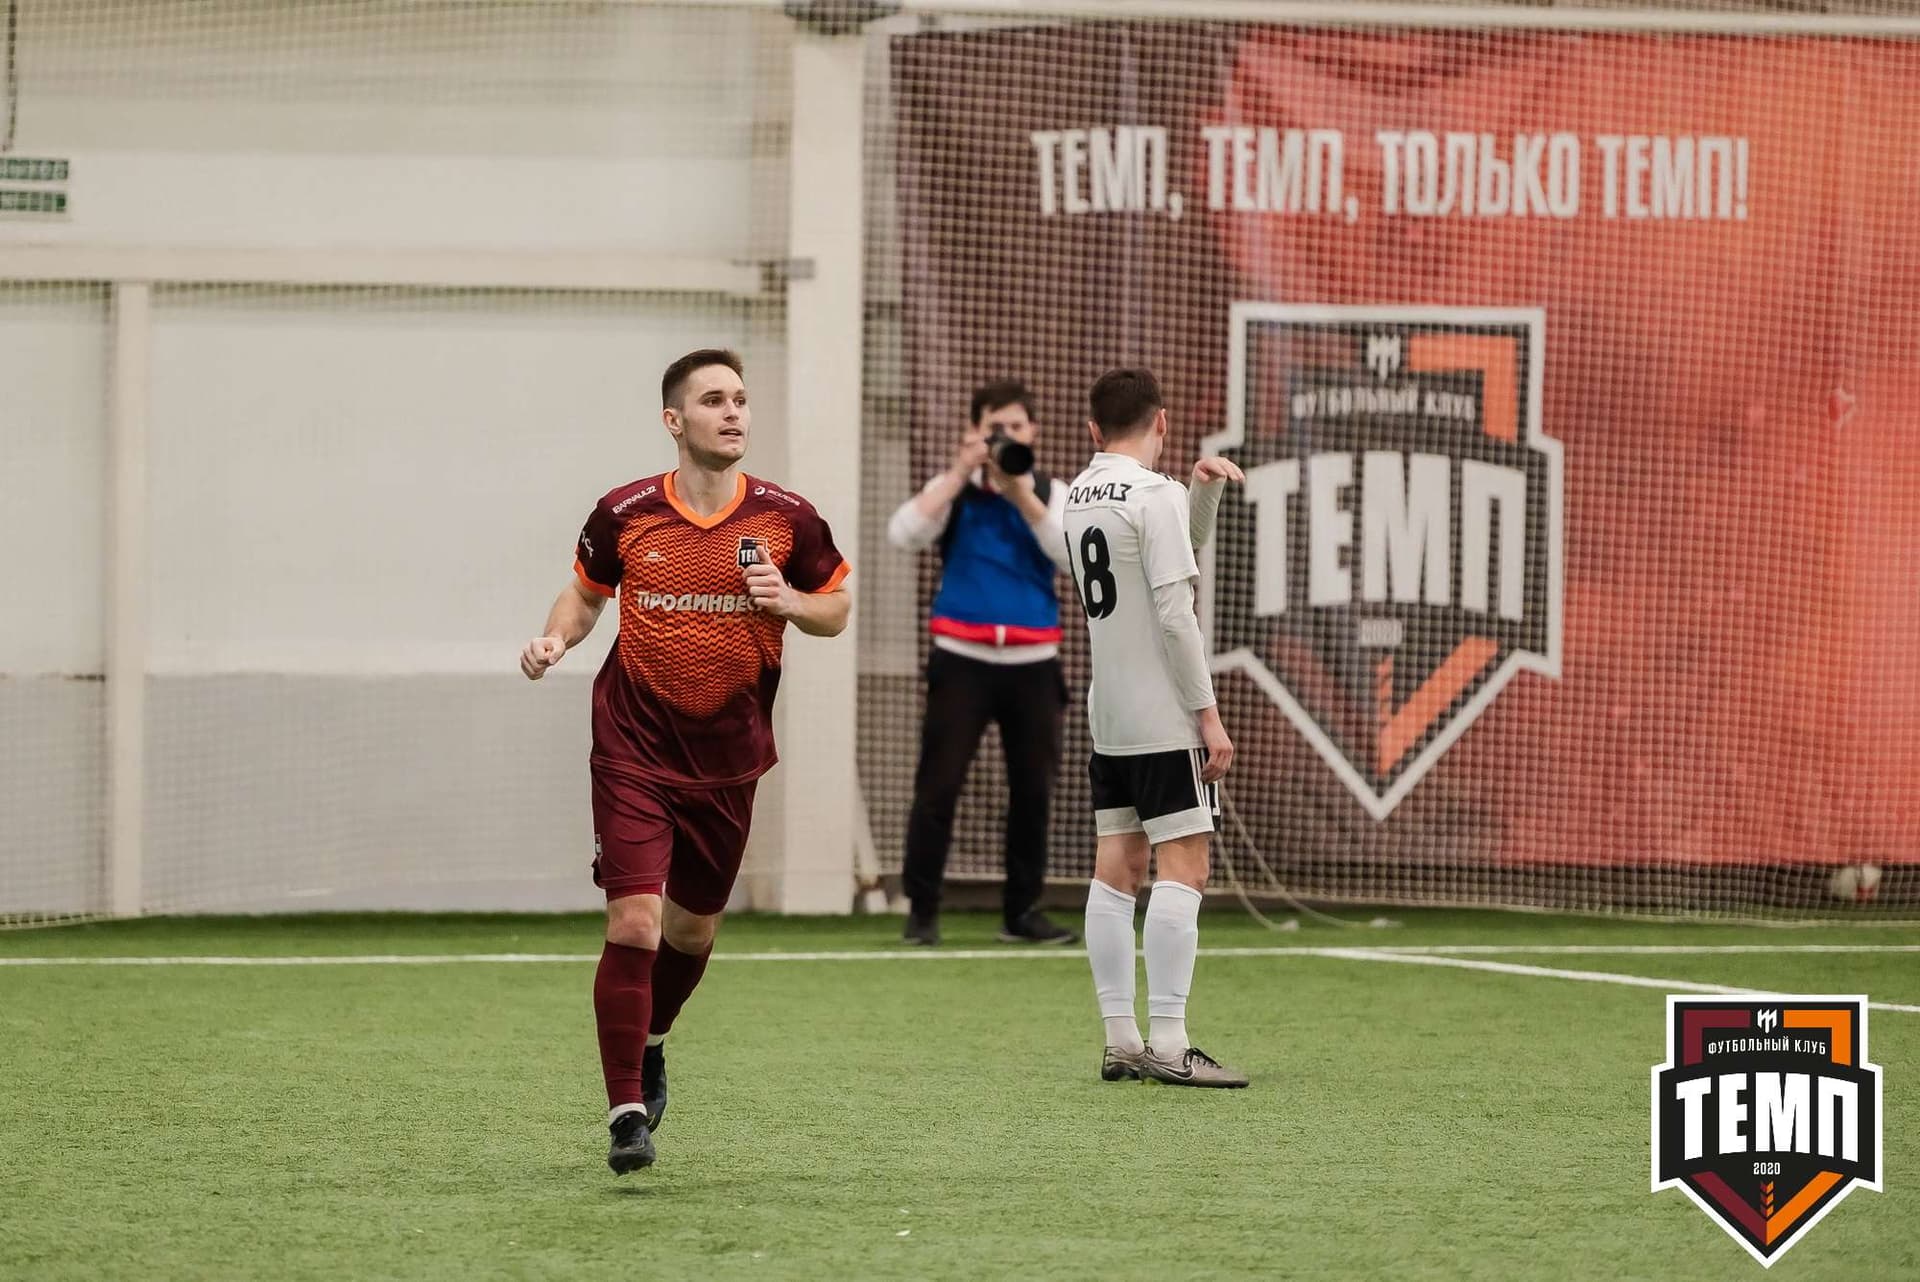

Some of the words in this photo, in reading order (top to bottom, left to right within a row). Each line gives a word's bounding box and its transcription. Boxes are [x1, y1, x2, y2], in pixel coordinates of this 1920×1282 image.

[1031, 126, 1184, 220] ТЕМП,
[1200, 127, 1359, 223] ТЕМП,
[1377, 130, 1580, 219] ТОЛЬКО
[1594, 135, 1749, 221] ТЕМП!
[1068, 483, 1132, 504] АЛМАЗ
[740, 548, 761, 563] ТЕМ
[1244, 450, 1527, 622] ТЕМП
[1065, 526, 1117, 619] 8
[637, 591, 763, 613] ПРОДИНВЕС
